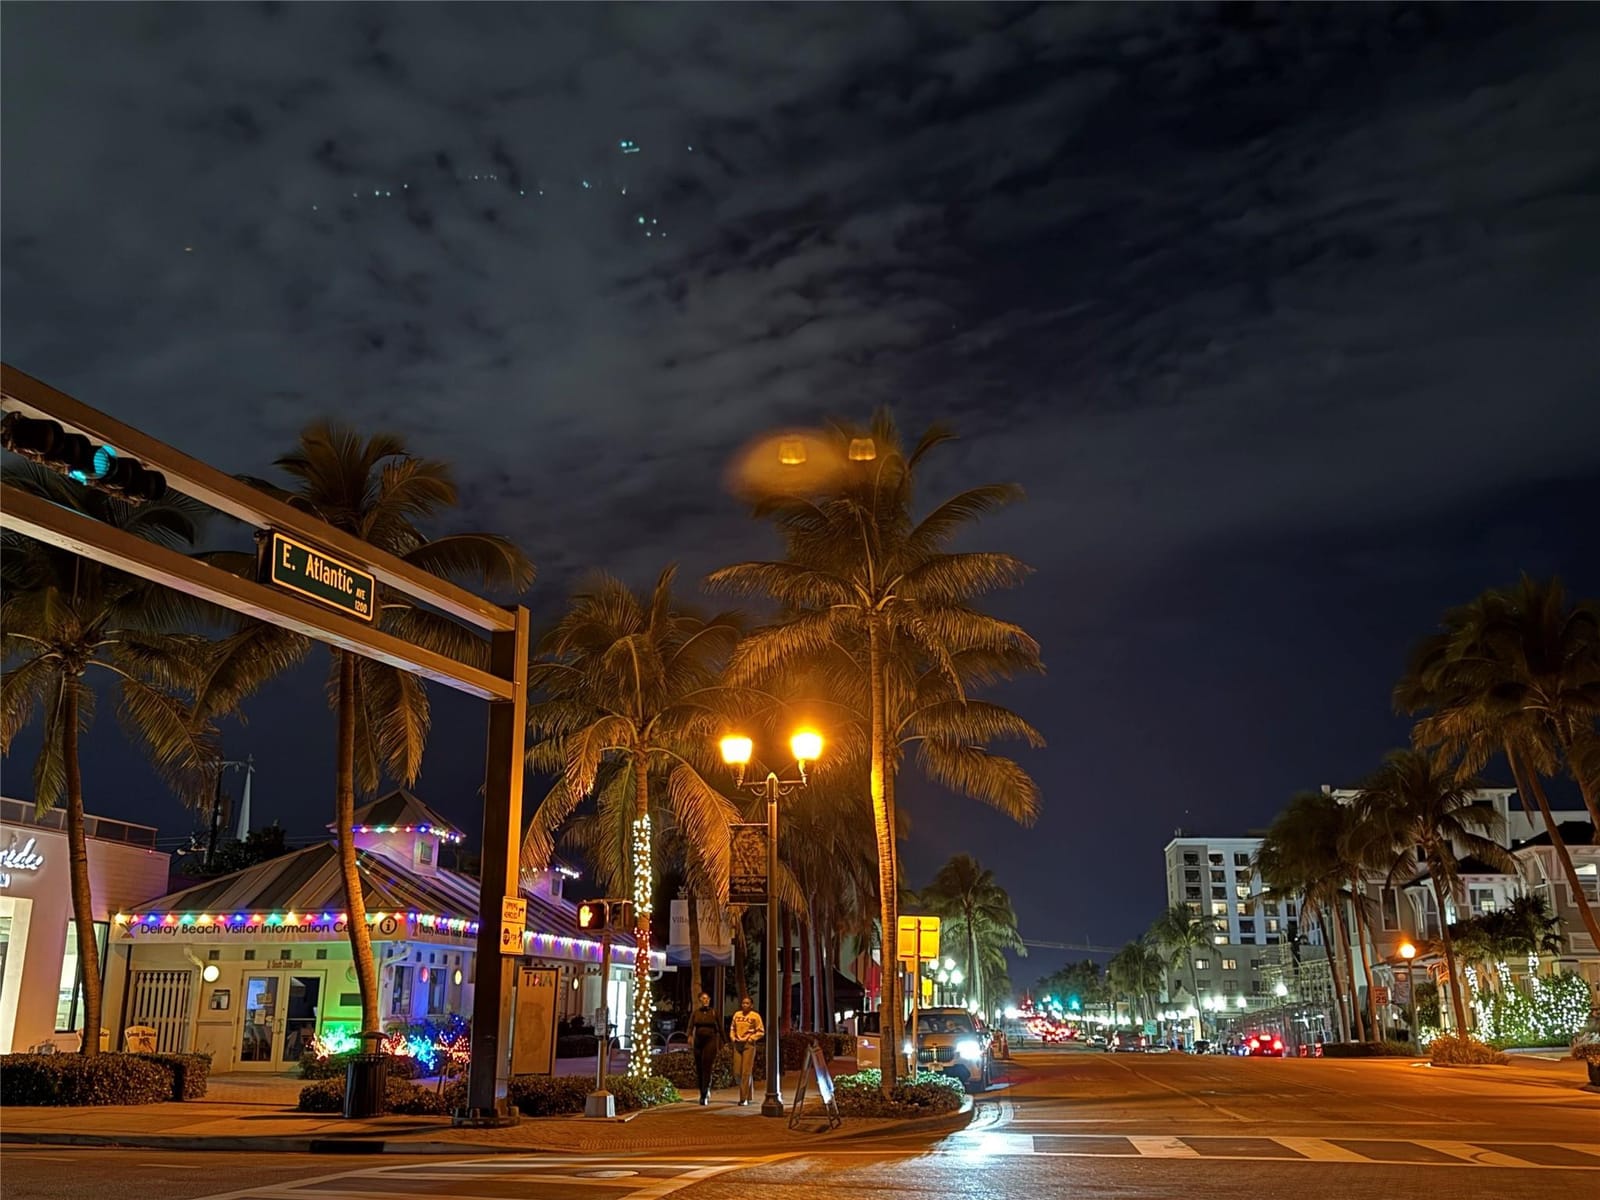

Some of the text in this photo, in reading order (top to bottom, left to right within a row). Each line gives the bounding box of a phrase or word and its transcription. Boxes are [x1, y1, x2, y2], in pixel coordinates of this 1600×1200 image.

[282, 542, 296, 571] E.
[305, 553, 354, 594] Atlantic
[141, 923, 179, 936] Delray
[181, 923, 220, 934] Beach
[224, 923, 259, 934] Visitor
[261, 922, 330, 934] Information
